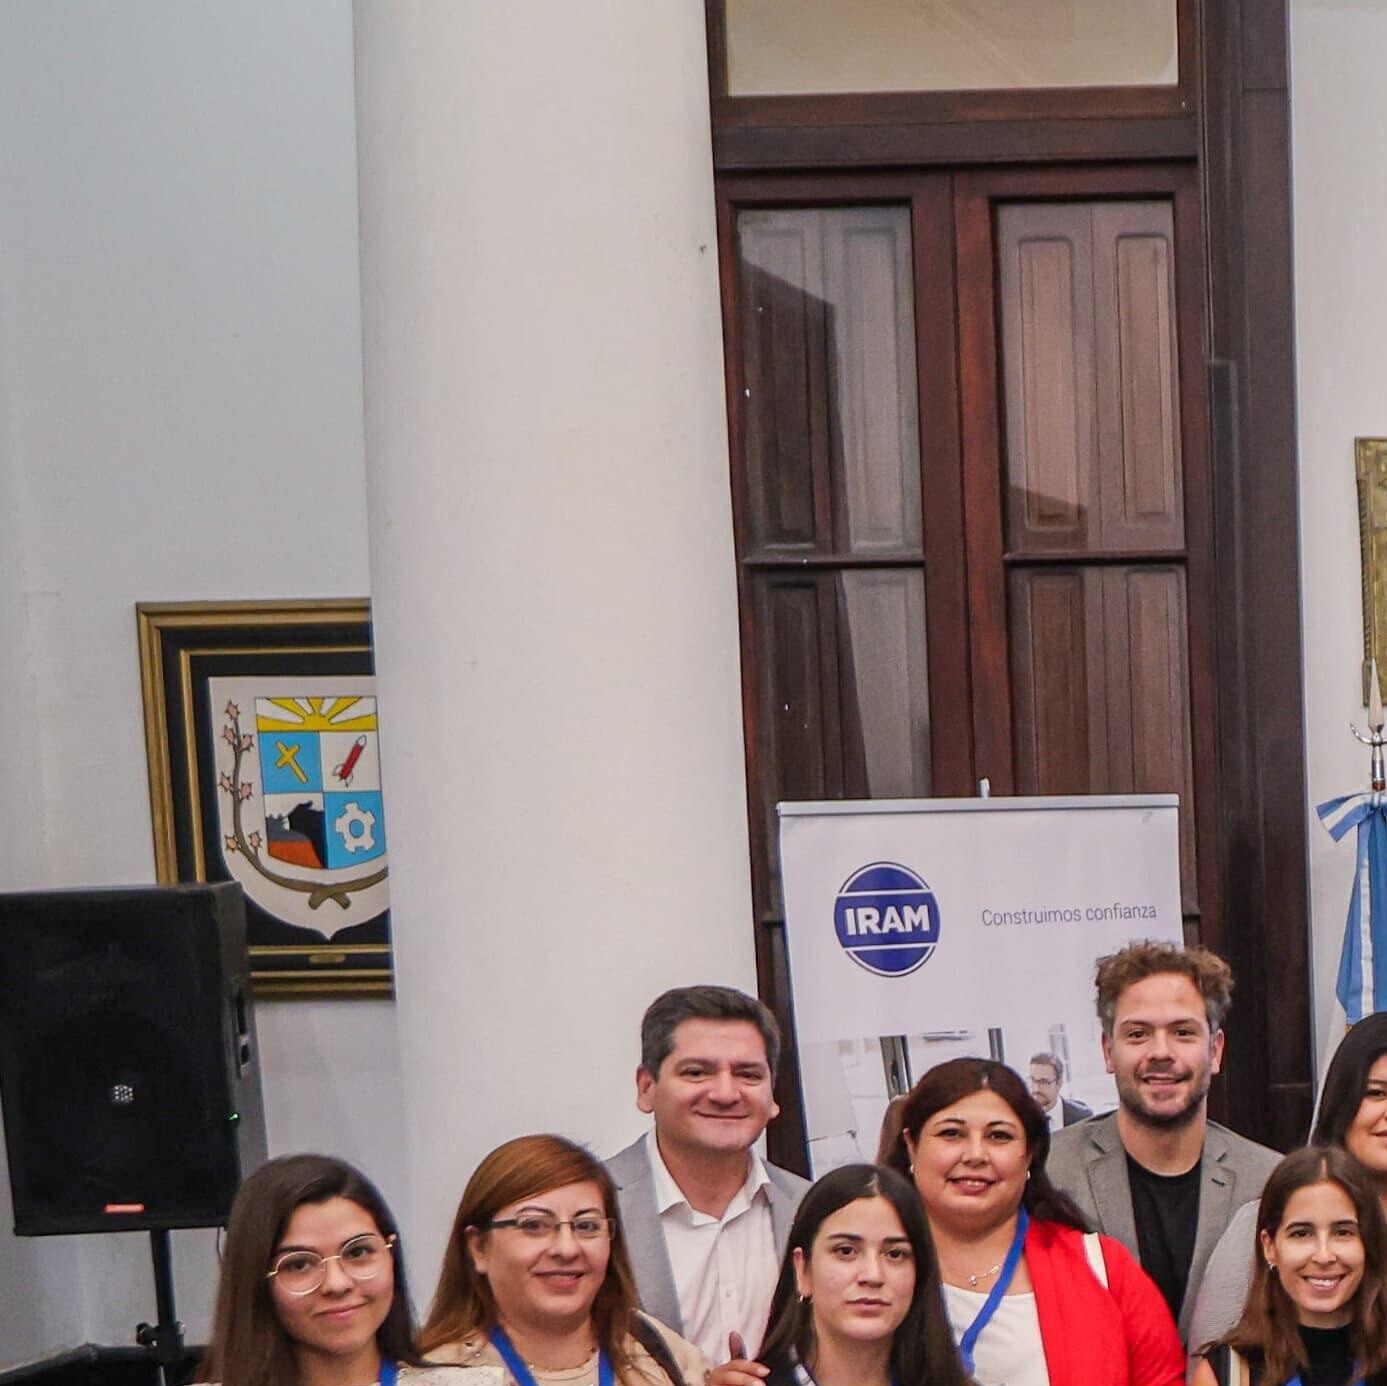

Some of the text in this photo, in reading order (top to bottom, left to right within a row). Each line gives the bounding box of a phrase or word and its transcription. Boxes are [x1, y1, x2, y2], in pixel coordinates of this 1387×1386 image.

[844, 903, 931, 936] IRAM
[981, 902, 1157, 927] Construimos confianza
